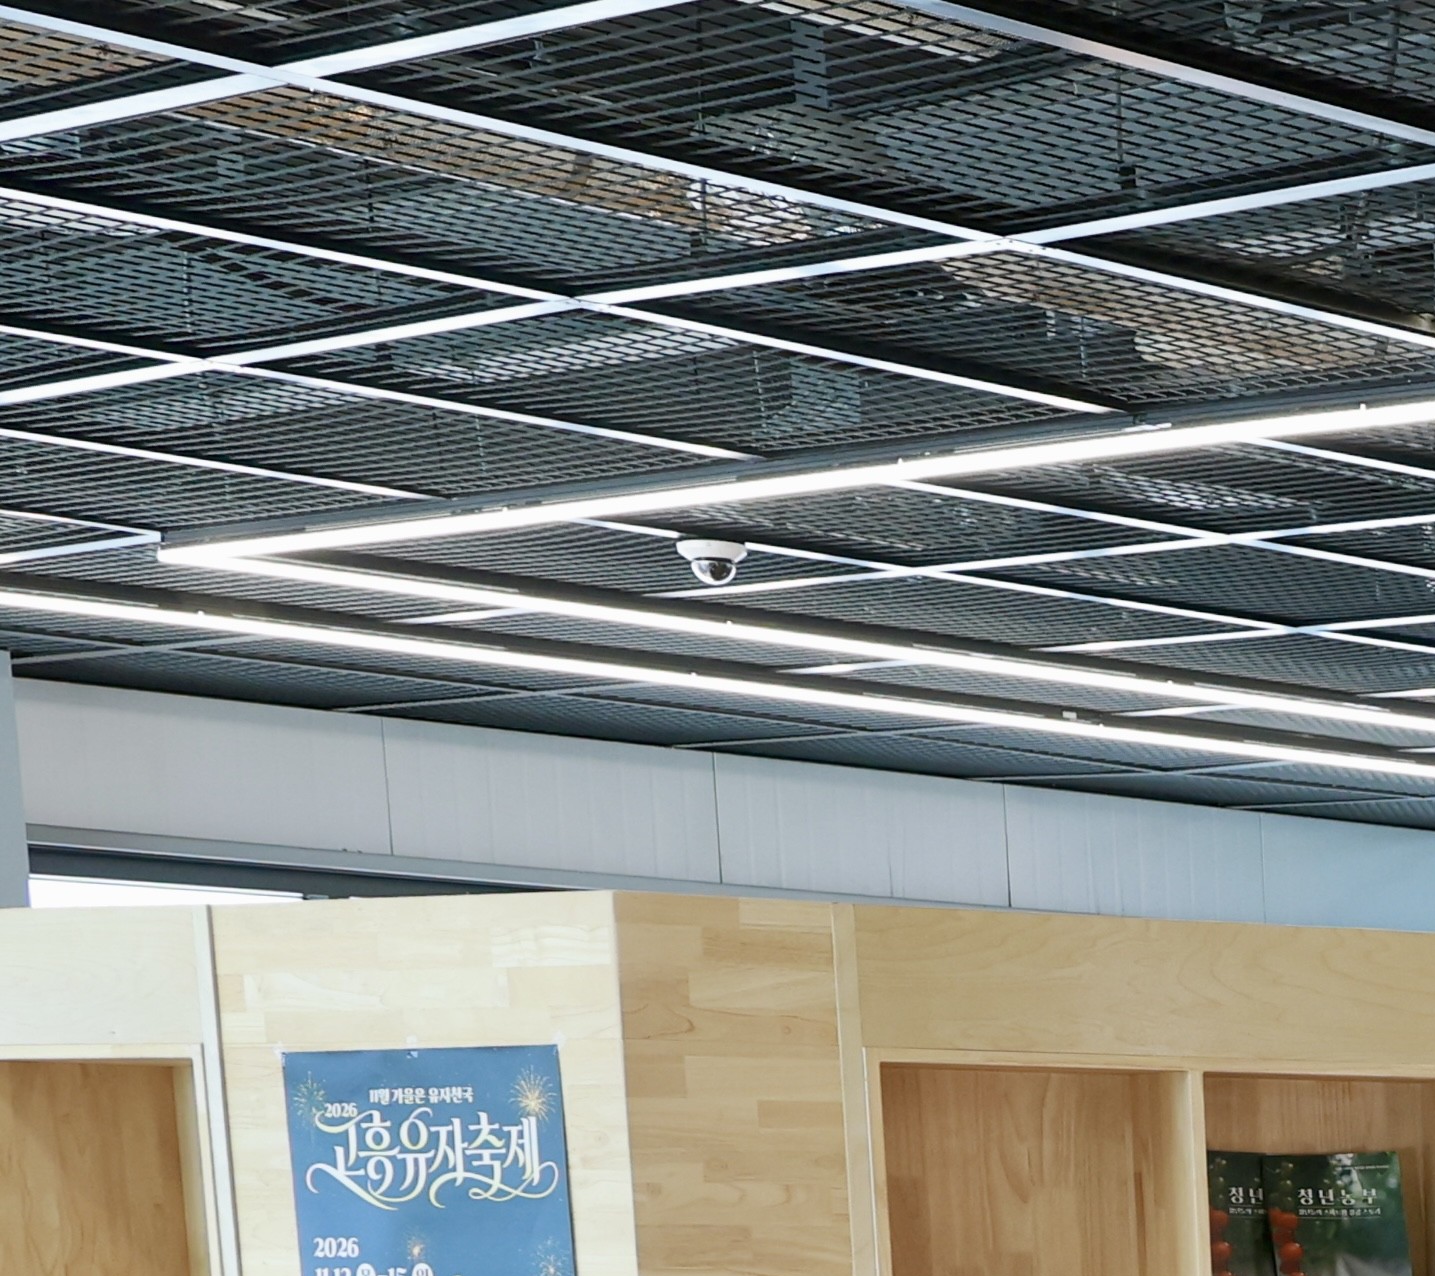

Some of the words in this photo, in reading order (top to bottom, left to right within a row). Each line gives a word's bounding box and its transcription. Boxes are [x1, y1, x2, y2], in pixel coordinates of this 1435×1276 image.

[369, 1089, 390, 1105] 11월
[391, 1087, 427, 1105] 가을은
[429, 1086, 474, 1104] 유자천국
[324, 1103, 358, 1118] 2026
[306, 1107, 559, 1210] 고흥유자축제
[313, 1237, 360, 1258] 2026
